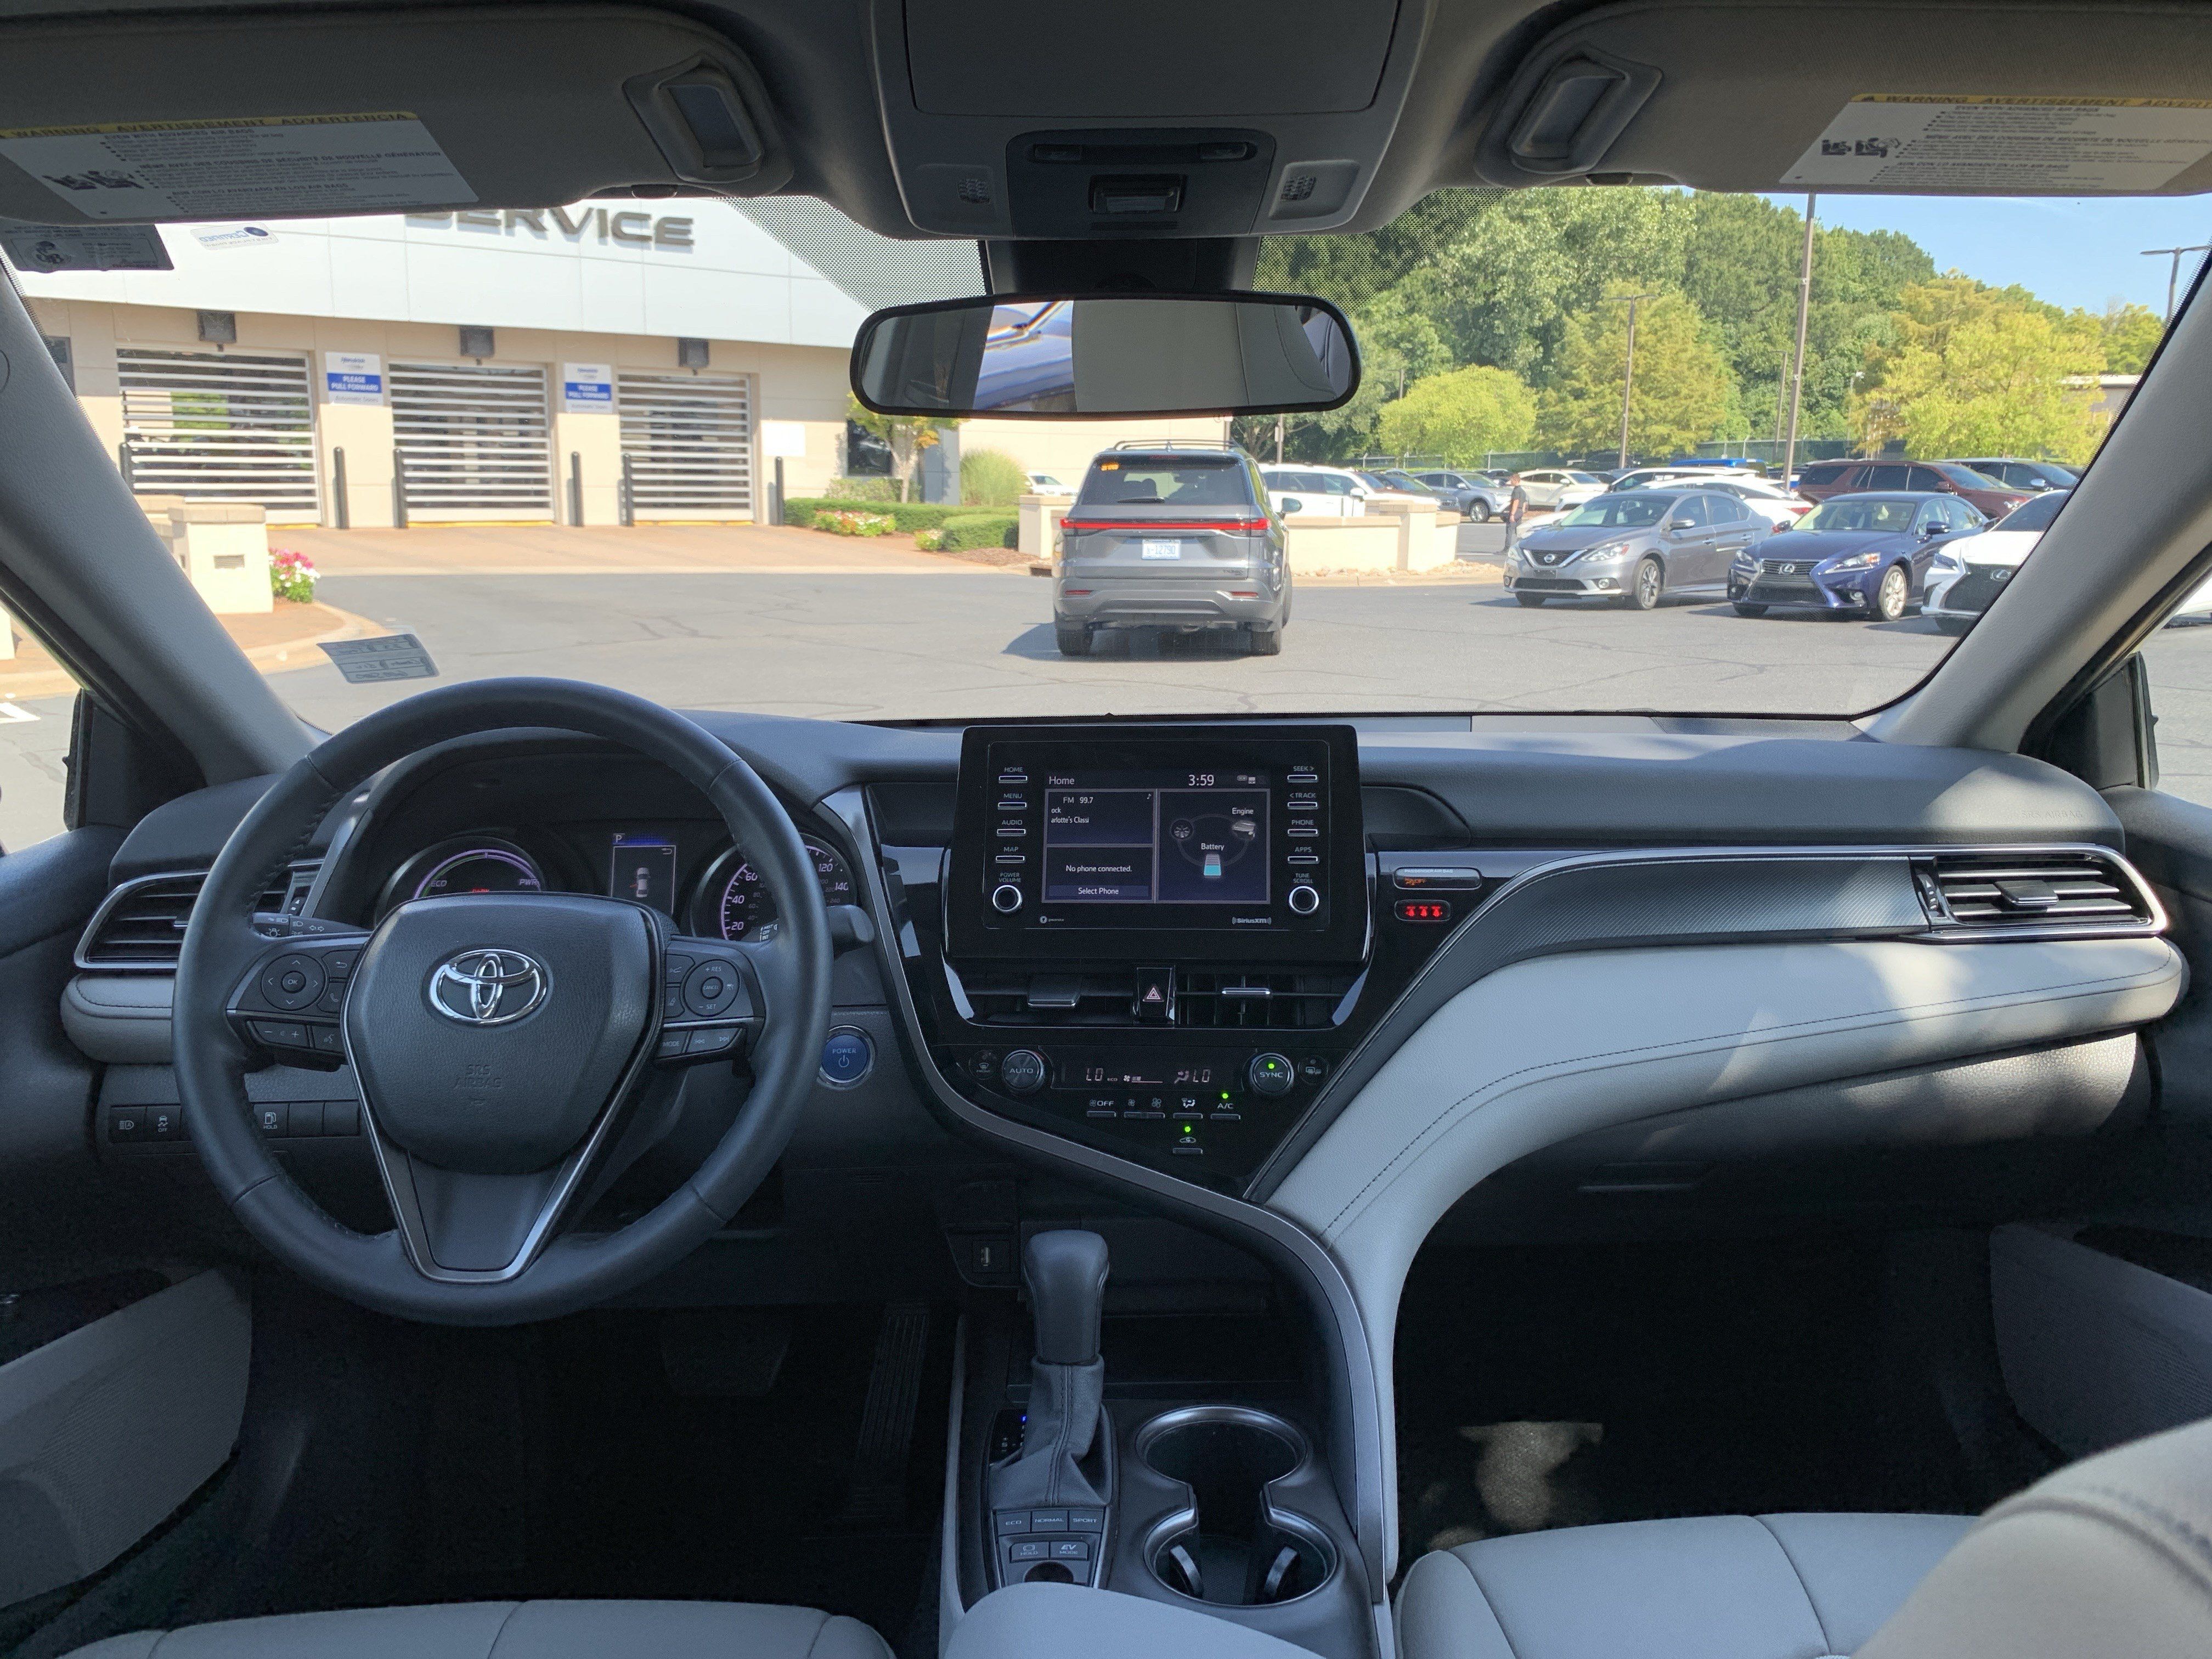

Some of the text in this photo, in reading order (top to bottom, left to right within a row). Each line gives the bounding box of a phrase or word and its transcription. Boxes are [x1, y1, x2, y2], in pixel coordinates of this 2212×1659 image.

[12, 112, 408, 137] WARNING AVERTISSEMENT ADVERTENCIA
[404, 206, 695, 246] ERVICE
[1049, 776, 1075, 785] Home
[1189, 775, 1214, 787] 3:59
[1232, 808, 1254, 816] Engine
[615, 834, 623, 843] P
[1201, 843, 1224, 851] Battery
[819, 863, 833, 872] 120
[1076, 865, 1098, 874] phone
[746, 872, 758, 882] 60
[835, 882, 849, 891] 140
[732, 895, 744, 904] 40
[731, 922, 744, 930] 20
